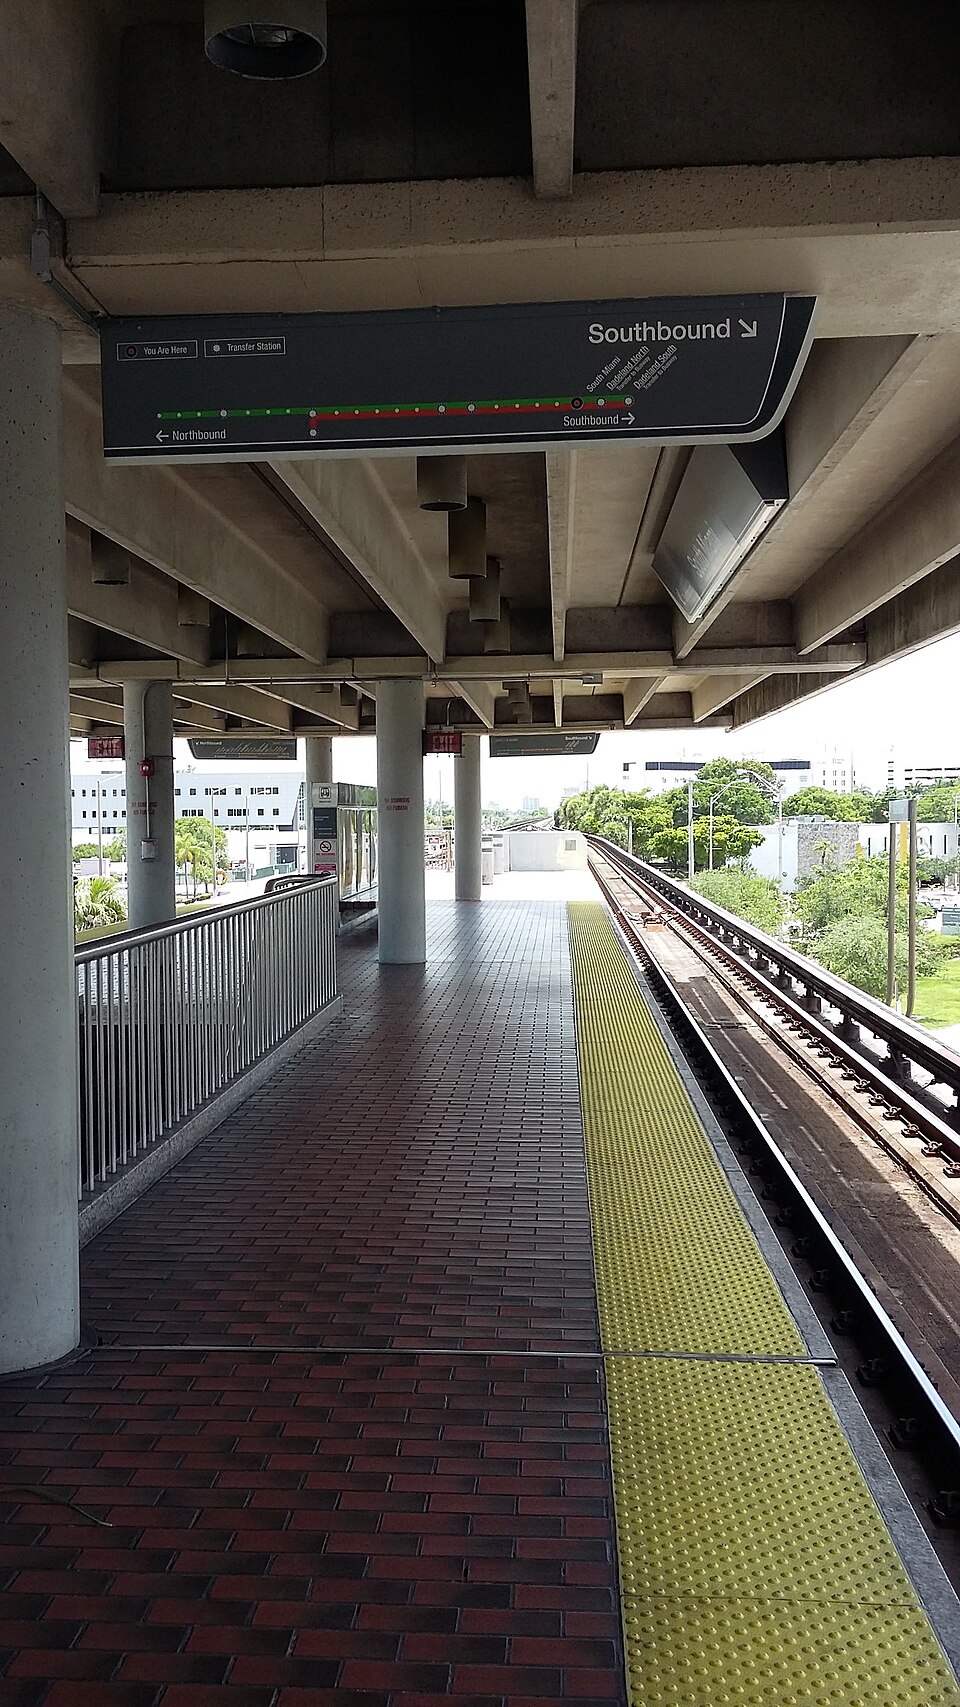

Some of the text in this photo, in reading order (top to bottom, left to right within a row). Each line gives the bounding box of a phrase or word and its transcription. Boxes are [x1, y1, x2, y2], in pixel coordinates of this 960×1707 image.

[588, 318, 731, 344] Southbound
[143, 345, 188, 356] You Are Here
[227, 342, 282, 352] Transfer Station
[586, 355, 621, 392] South Miami
[606, 345, 650, 391] Dadeland North
[633, 344, 678, 390] Dadeland South
[563, 414, 619, 427] Southbound
[172, 429, 226, 441] Northbound
[96, 739, 120, 757] EXIT
[432, 735, 454, 753] EXIT
